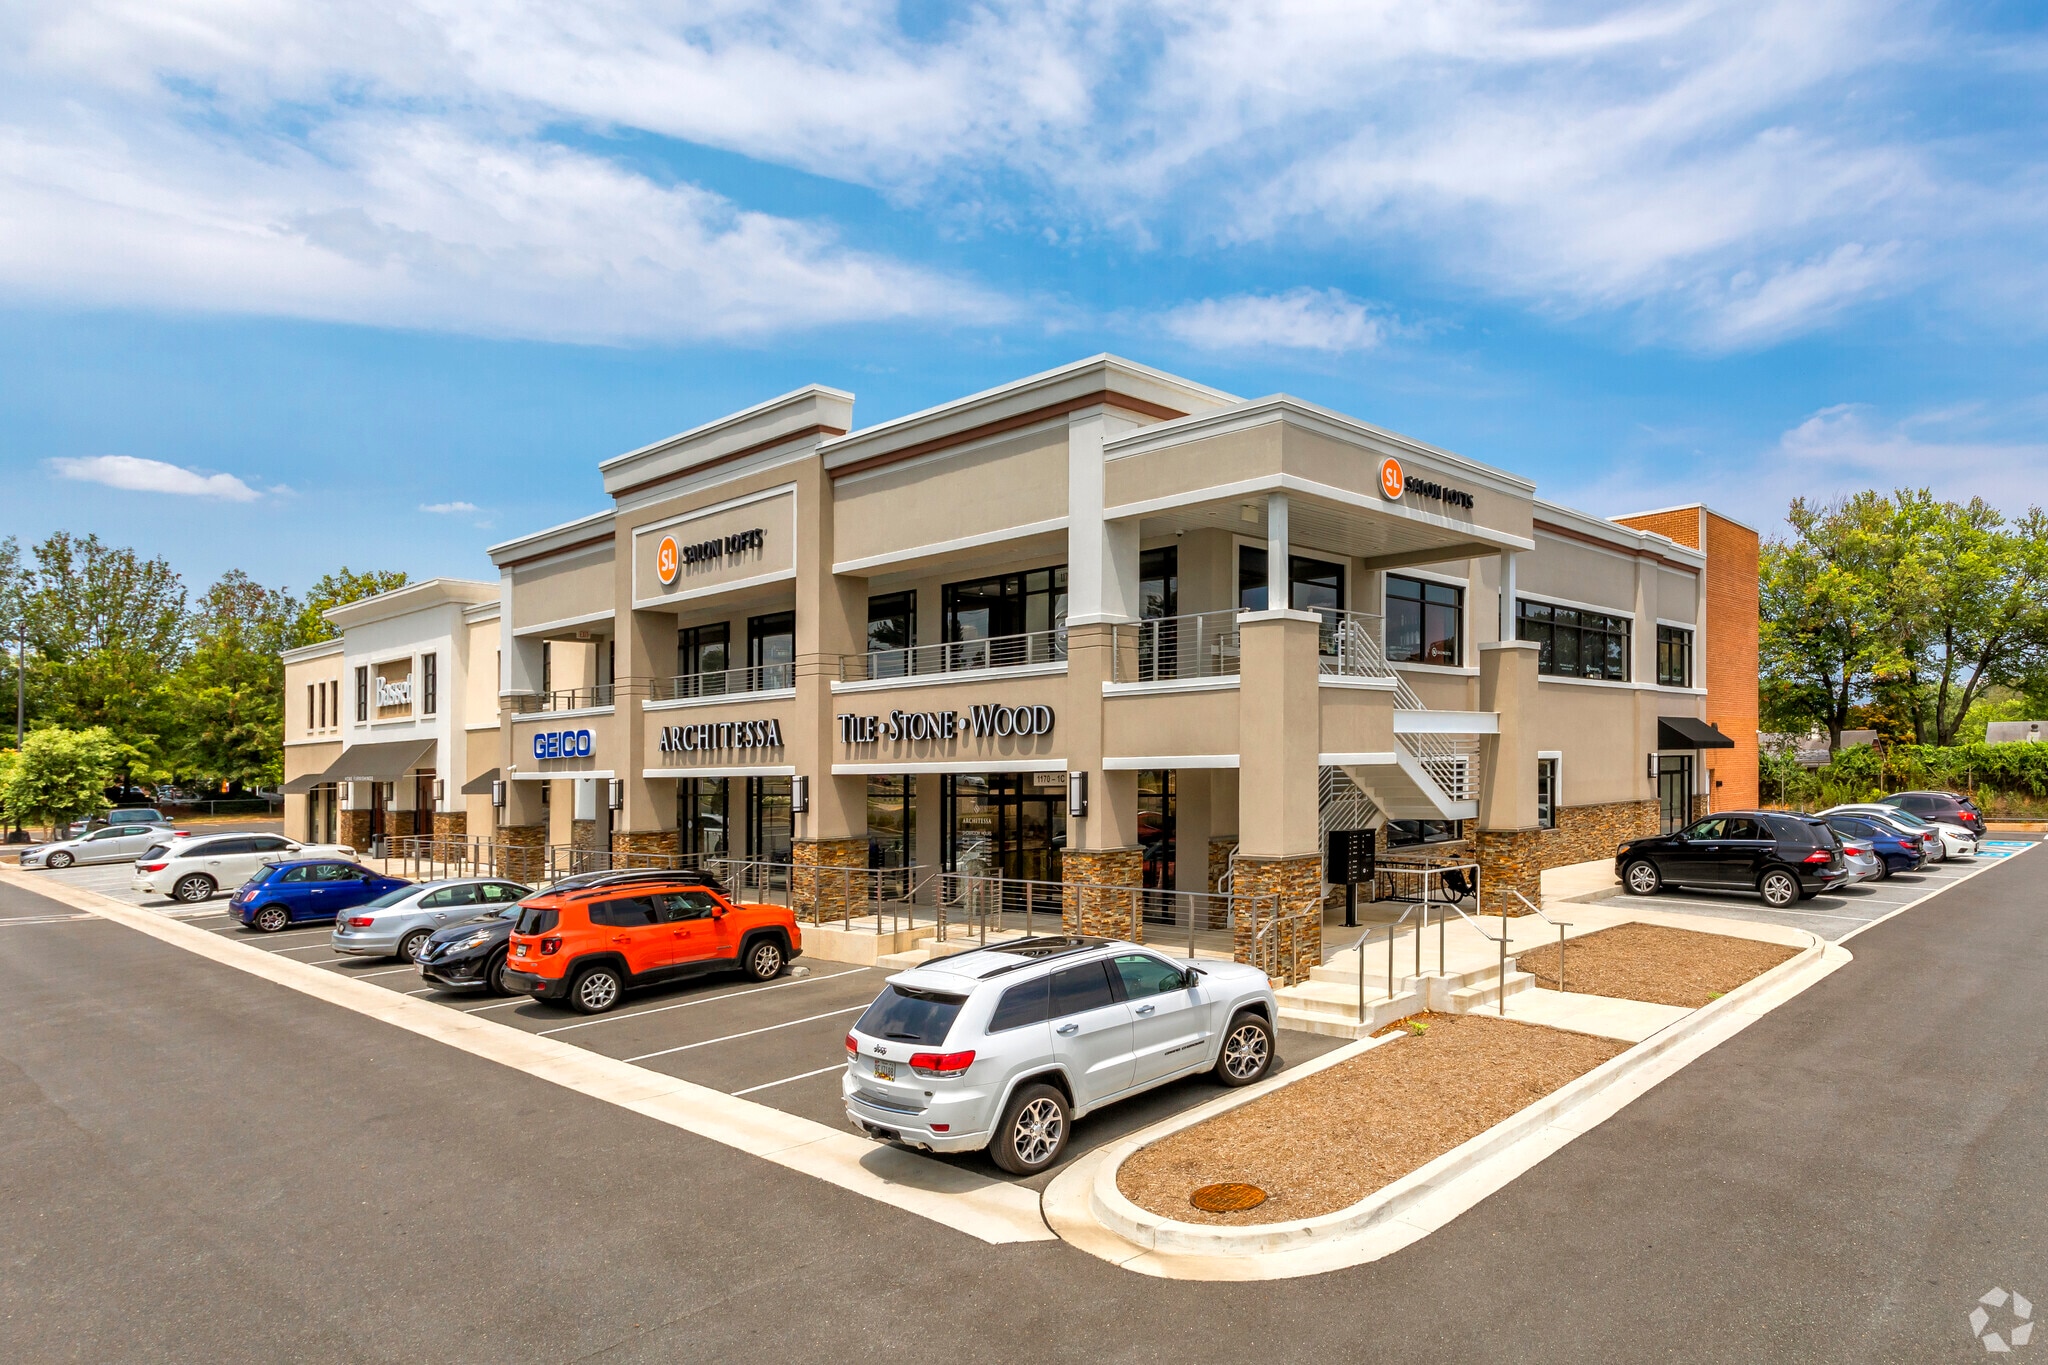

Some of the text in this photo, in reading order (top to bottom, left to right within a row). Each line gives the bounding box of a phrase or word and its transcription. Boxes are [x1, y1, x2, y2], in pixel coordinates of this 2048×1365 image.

[1385, 467, 1400, 489] SL
[1404, 475, 1442, 501] SALON
[682, 528, 764, 565] SALON LOFTS
[661, 548, 675, 572] SL
[659, 719, 782, 752] ARCHITESSA
[837, 703, 1055, 744] TILE STONE WOOD
[533, 729, 593, 760] GEICO
[1037, 774, 1050, 783] 1170
[962, 817, 992, 825] ARCHITESSA
